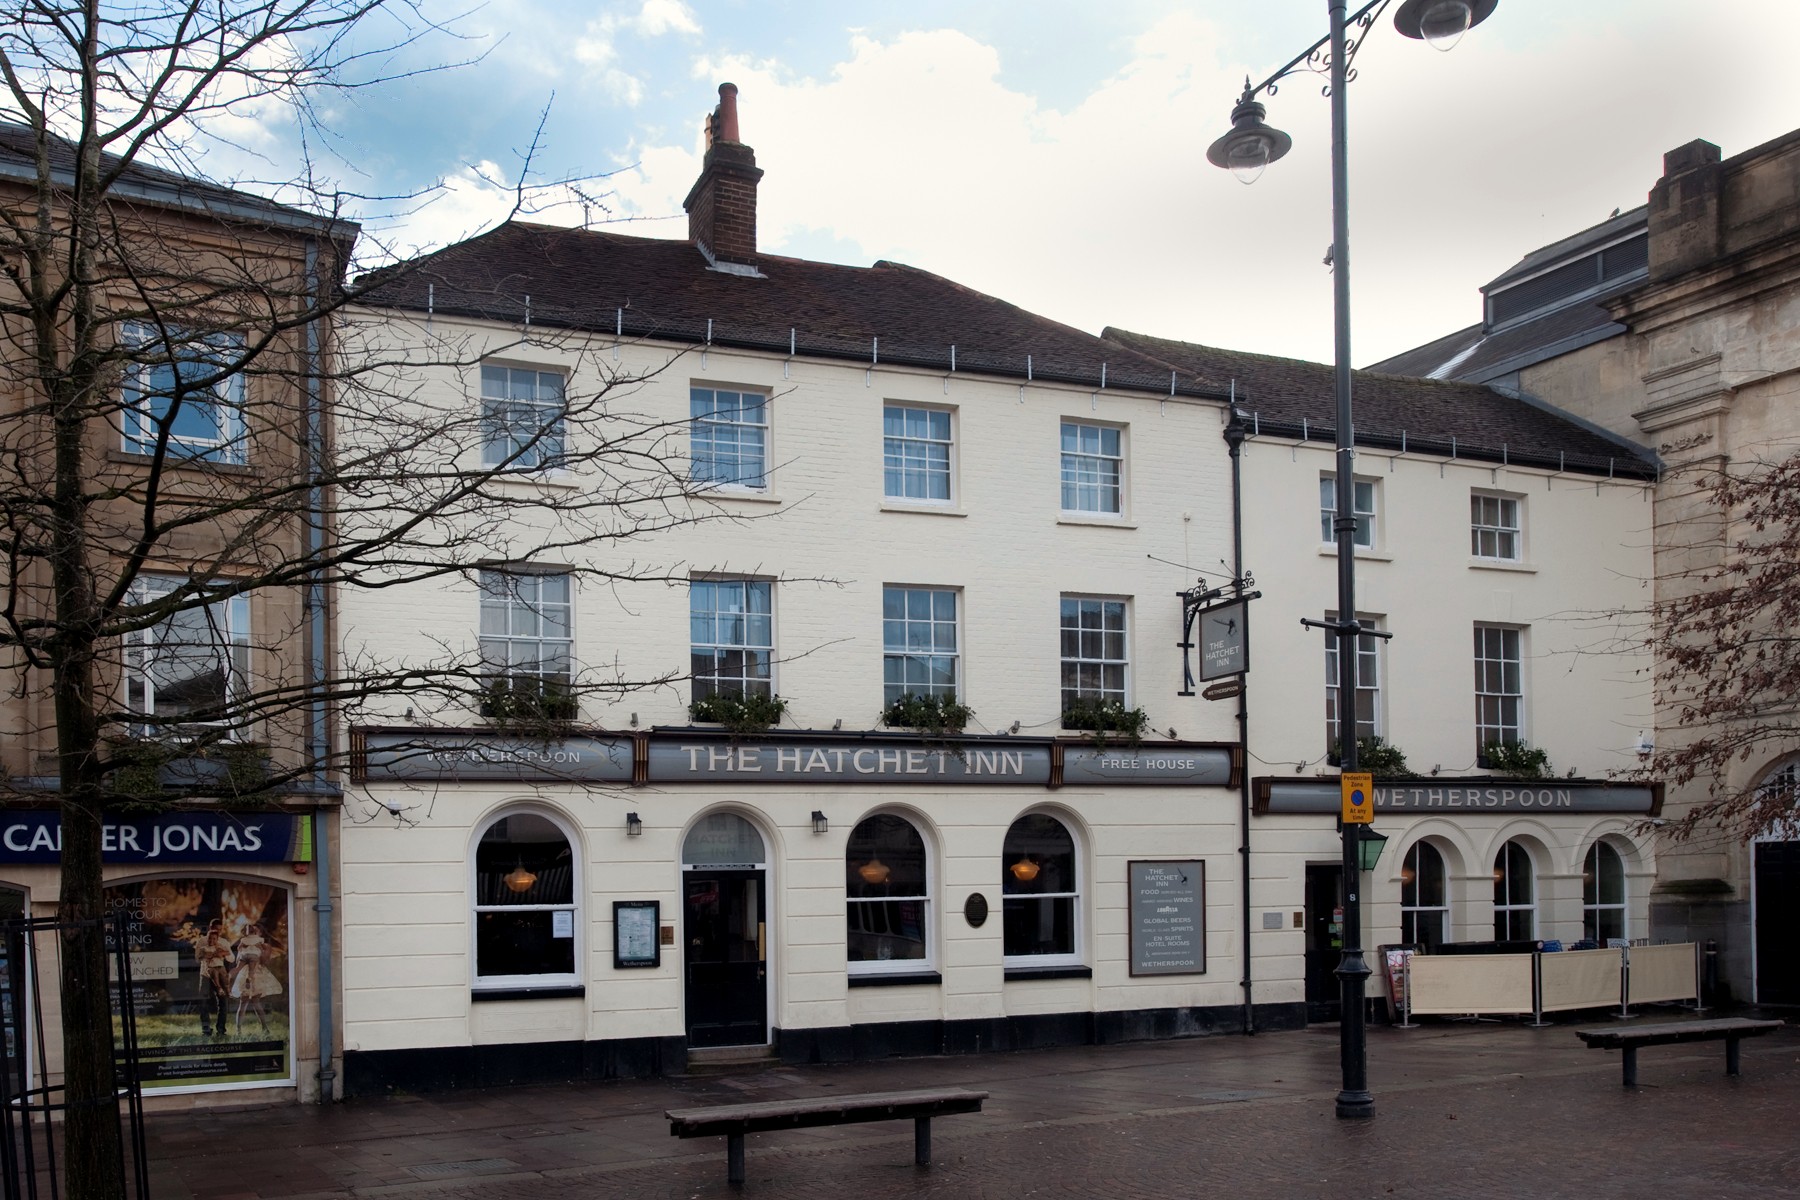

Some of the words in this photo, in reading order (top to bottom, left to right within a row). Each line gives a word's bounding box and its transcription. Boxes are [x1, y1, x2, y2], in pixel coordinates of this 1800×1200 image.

[1210, 640, 1224, 651] THE
[1206, 646, 1240, 661] HATCHET
[1216, 657, 1230, 668] INN
[1207, 685, 1238, 696] WETHERSPOON
[680, 746, 762, 772] THE
[775, 747, 953, 774] HATCHET
[964, 750, 1023, 775] INN
[1101, 759, 1140, 769] FREE
[1146, 760, 1195, 770] HOUSE
[1372, 788, 1571, 807] WETHERSPOON
[3, 824, 143, 851] CAER
[146, 825, 262, 858] JONAS
[104, 898, 148, 908] HOMES
[150, 898, 167, 906] TO
[128, 910, 162, 920] YOUR
[115, 966, 174, 976] LUNCHED
